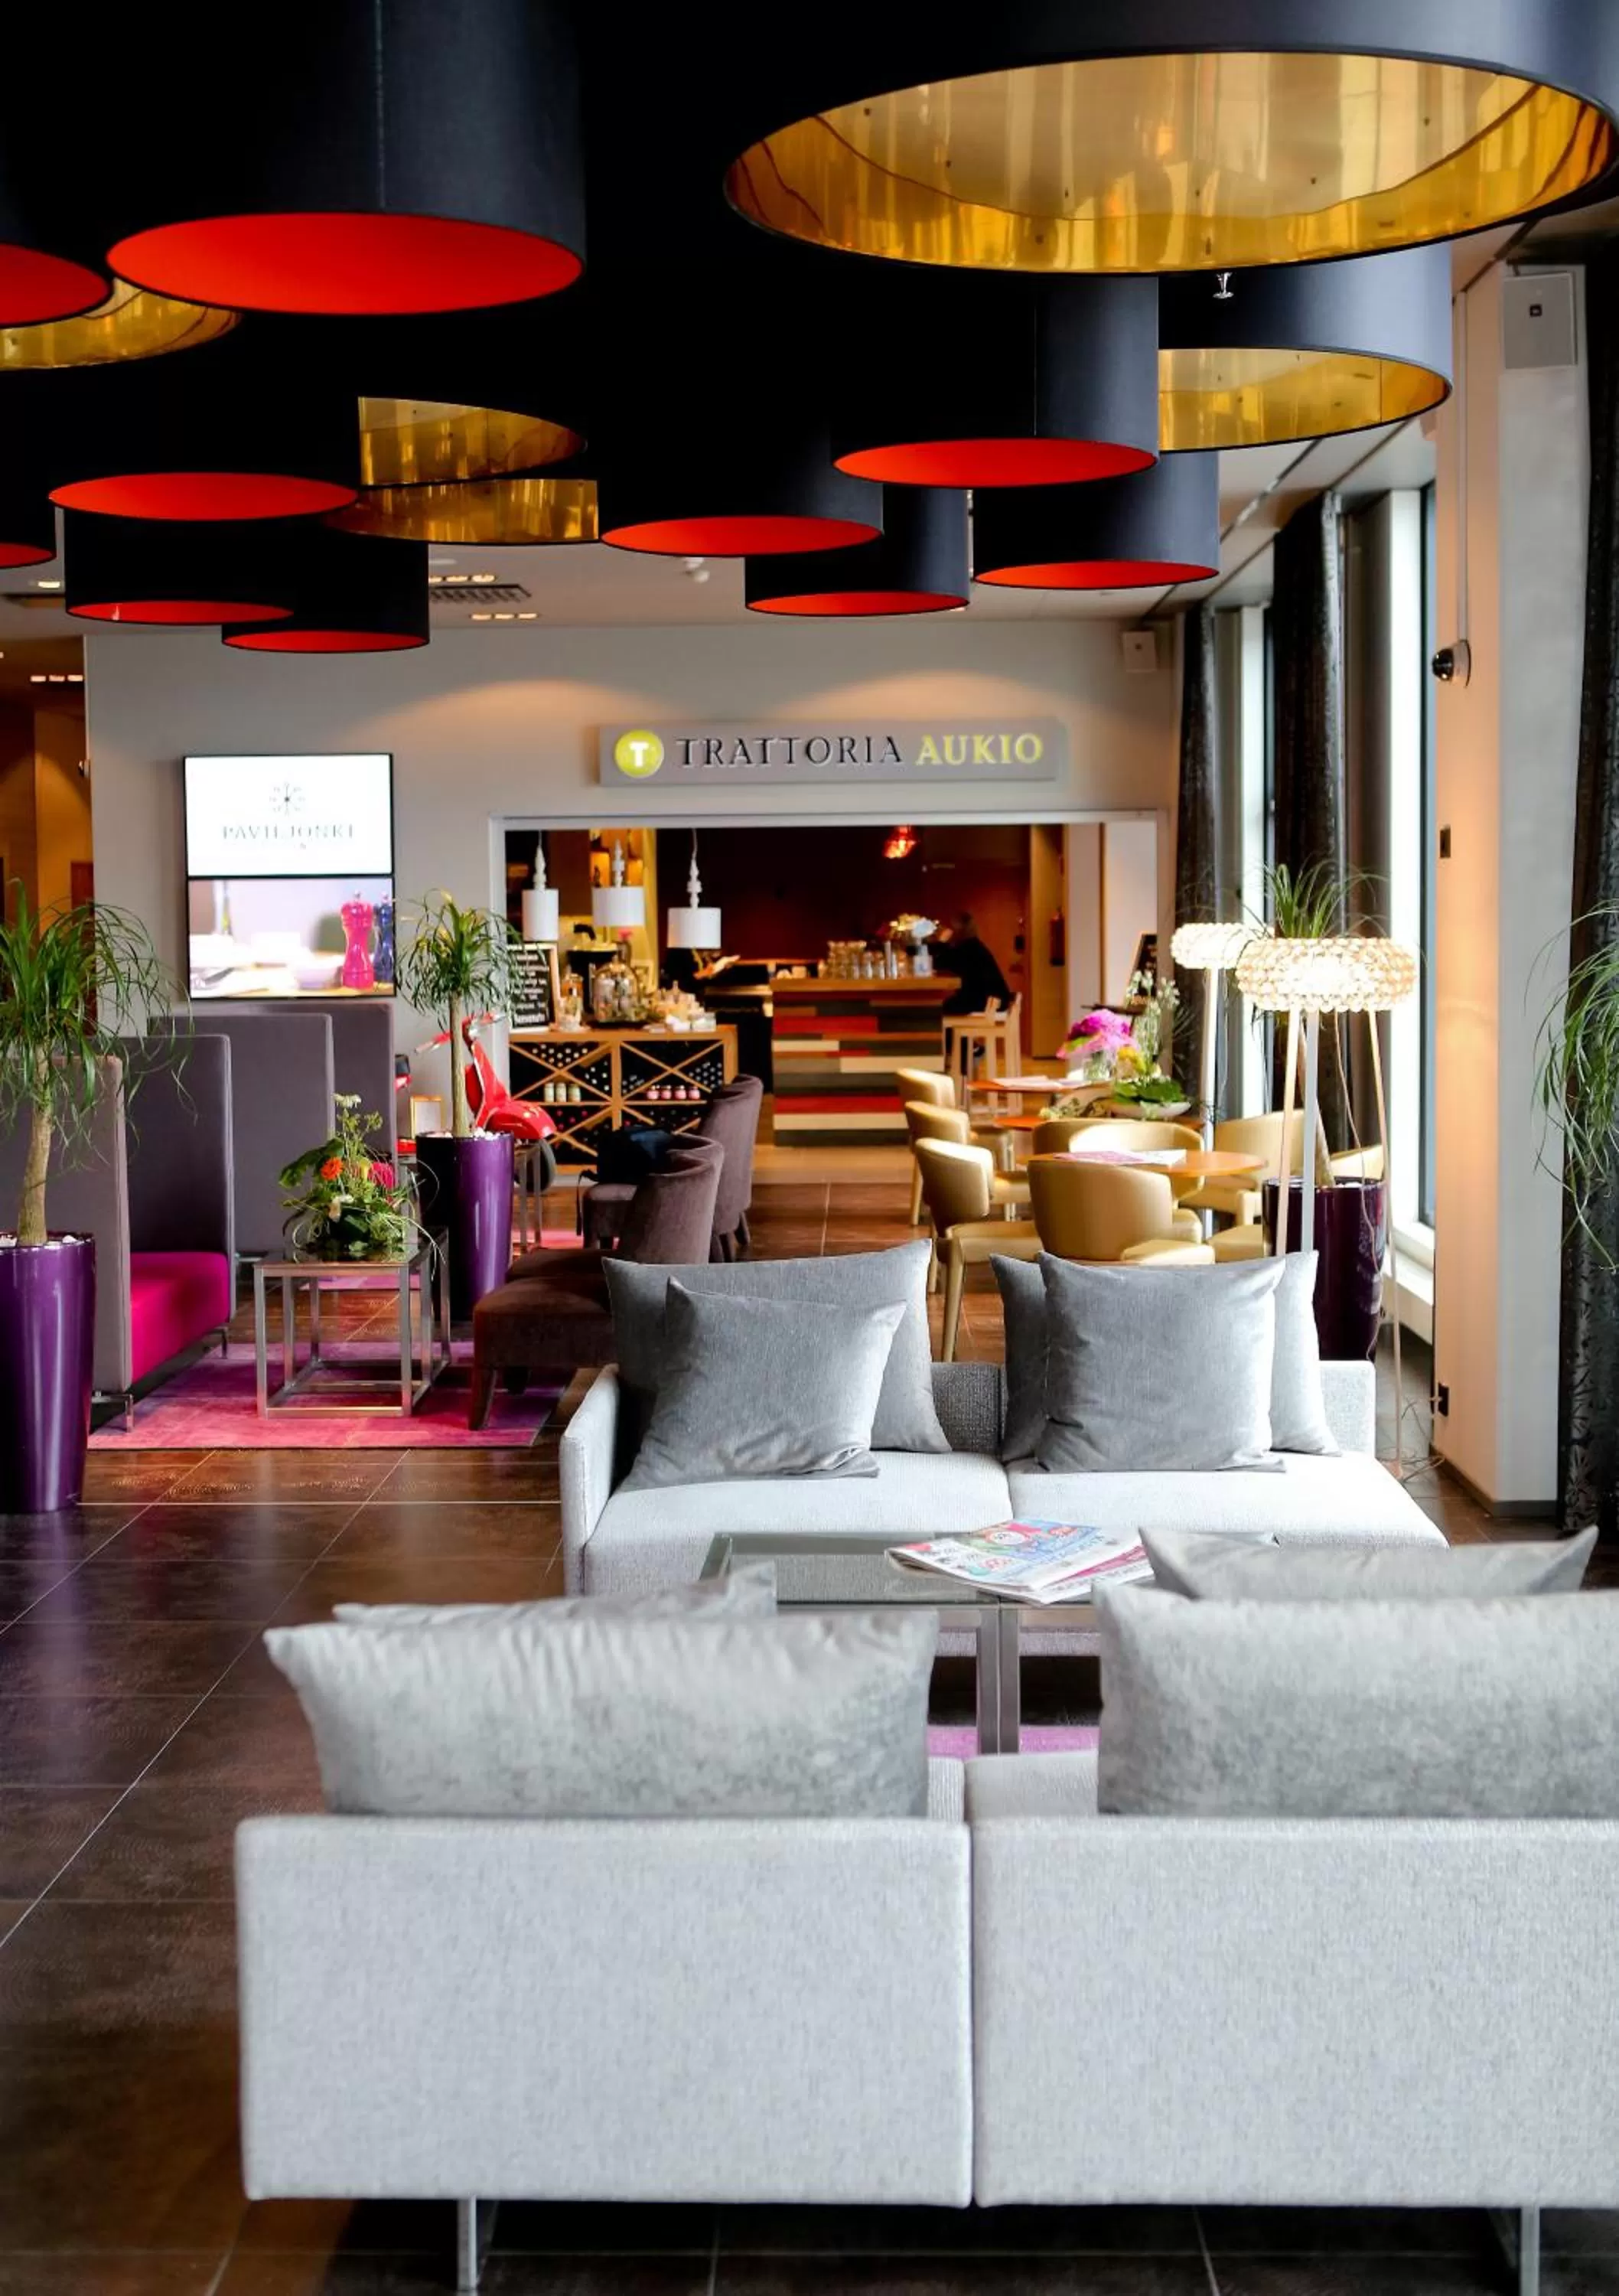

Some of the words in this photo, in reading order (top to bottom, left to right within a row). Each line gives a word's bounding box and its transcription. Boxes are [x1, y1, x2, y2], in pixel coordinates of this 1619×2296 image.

[628, 740, 650, 768] T
[676, 735, 904, 768] TRATTORIA
[915, 732, 1044, 767] AUKIO
